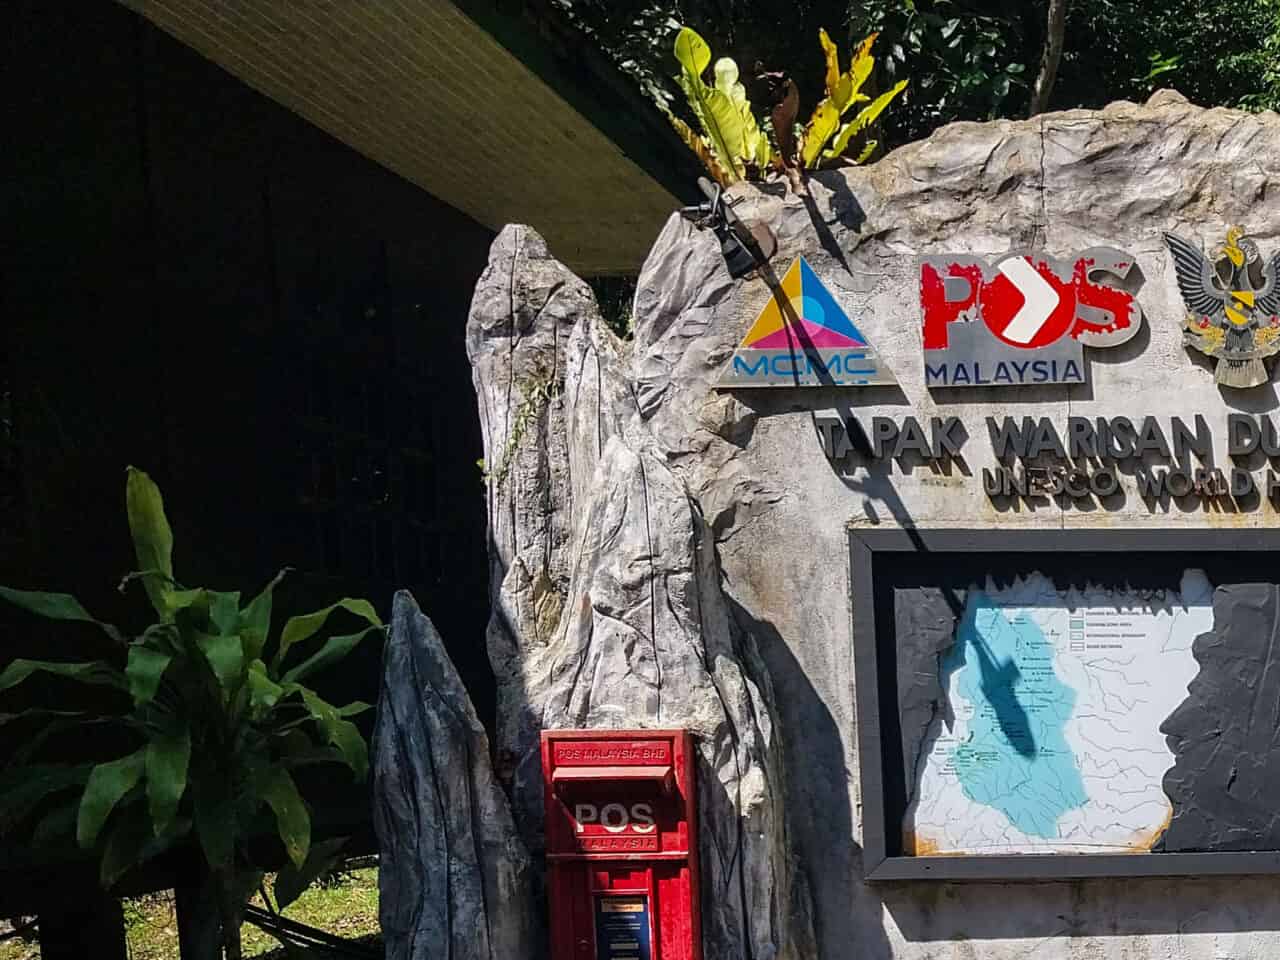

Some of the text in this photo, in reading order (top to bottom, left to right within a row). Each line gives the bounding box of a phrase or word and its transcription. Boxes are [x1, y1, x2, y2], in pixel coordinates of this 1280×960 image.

[920, 246, 1141, 348] POS
[733, 353, 876, 377] MCMC
[925, 359, 1084, 384] MALAYSIA
[815, 416, 964, 457] TAPAK
[984, 415, 1208, 458] WARISAN
[982, 466, 1119, 497] UNESCO
[1135, 467, 1253, 497] WORLD
[558, 749, 666, 760] POS MALAYSIA BHD
[575, 803, 656, 833] POS
